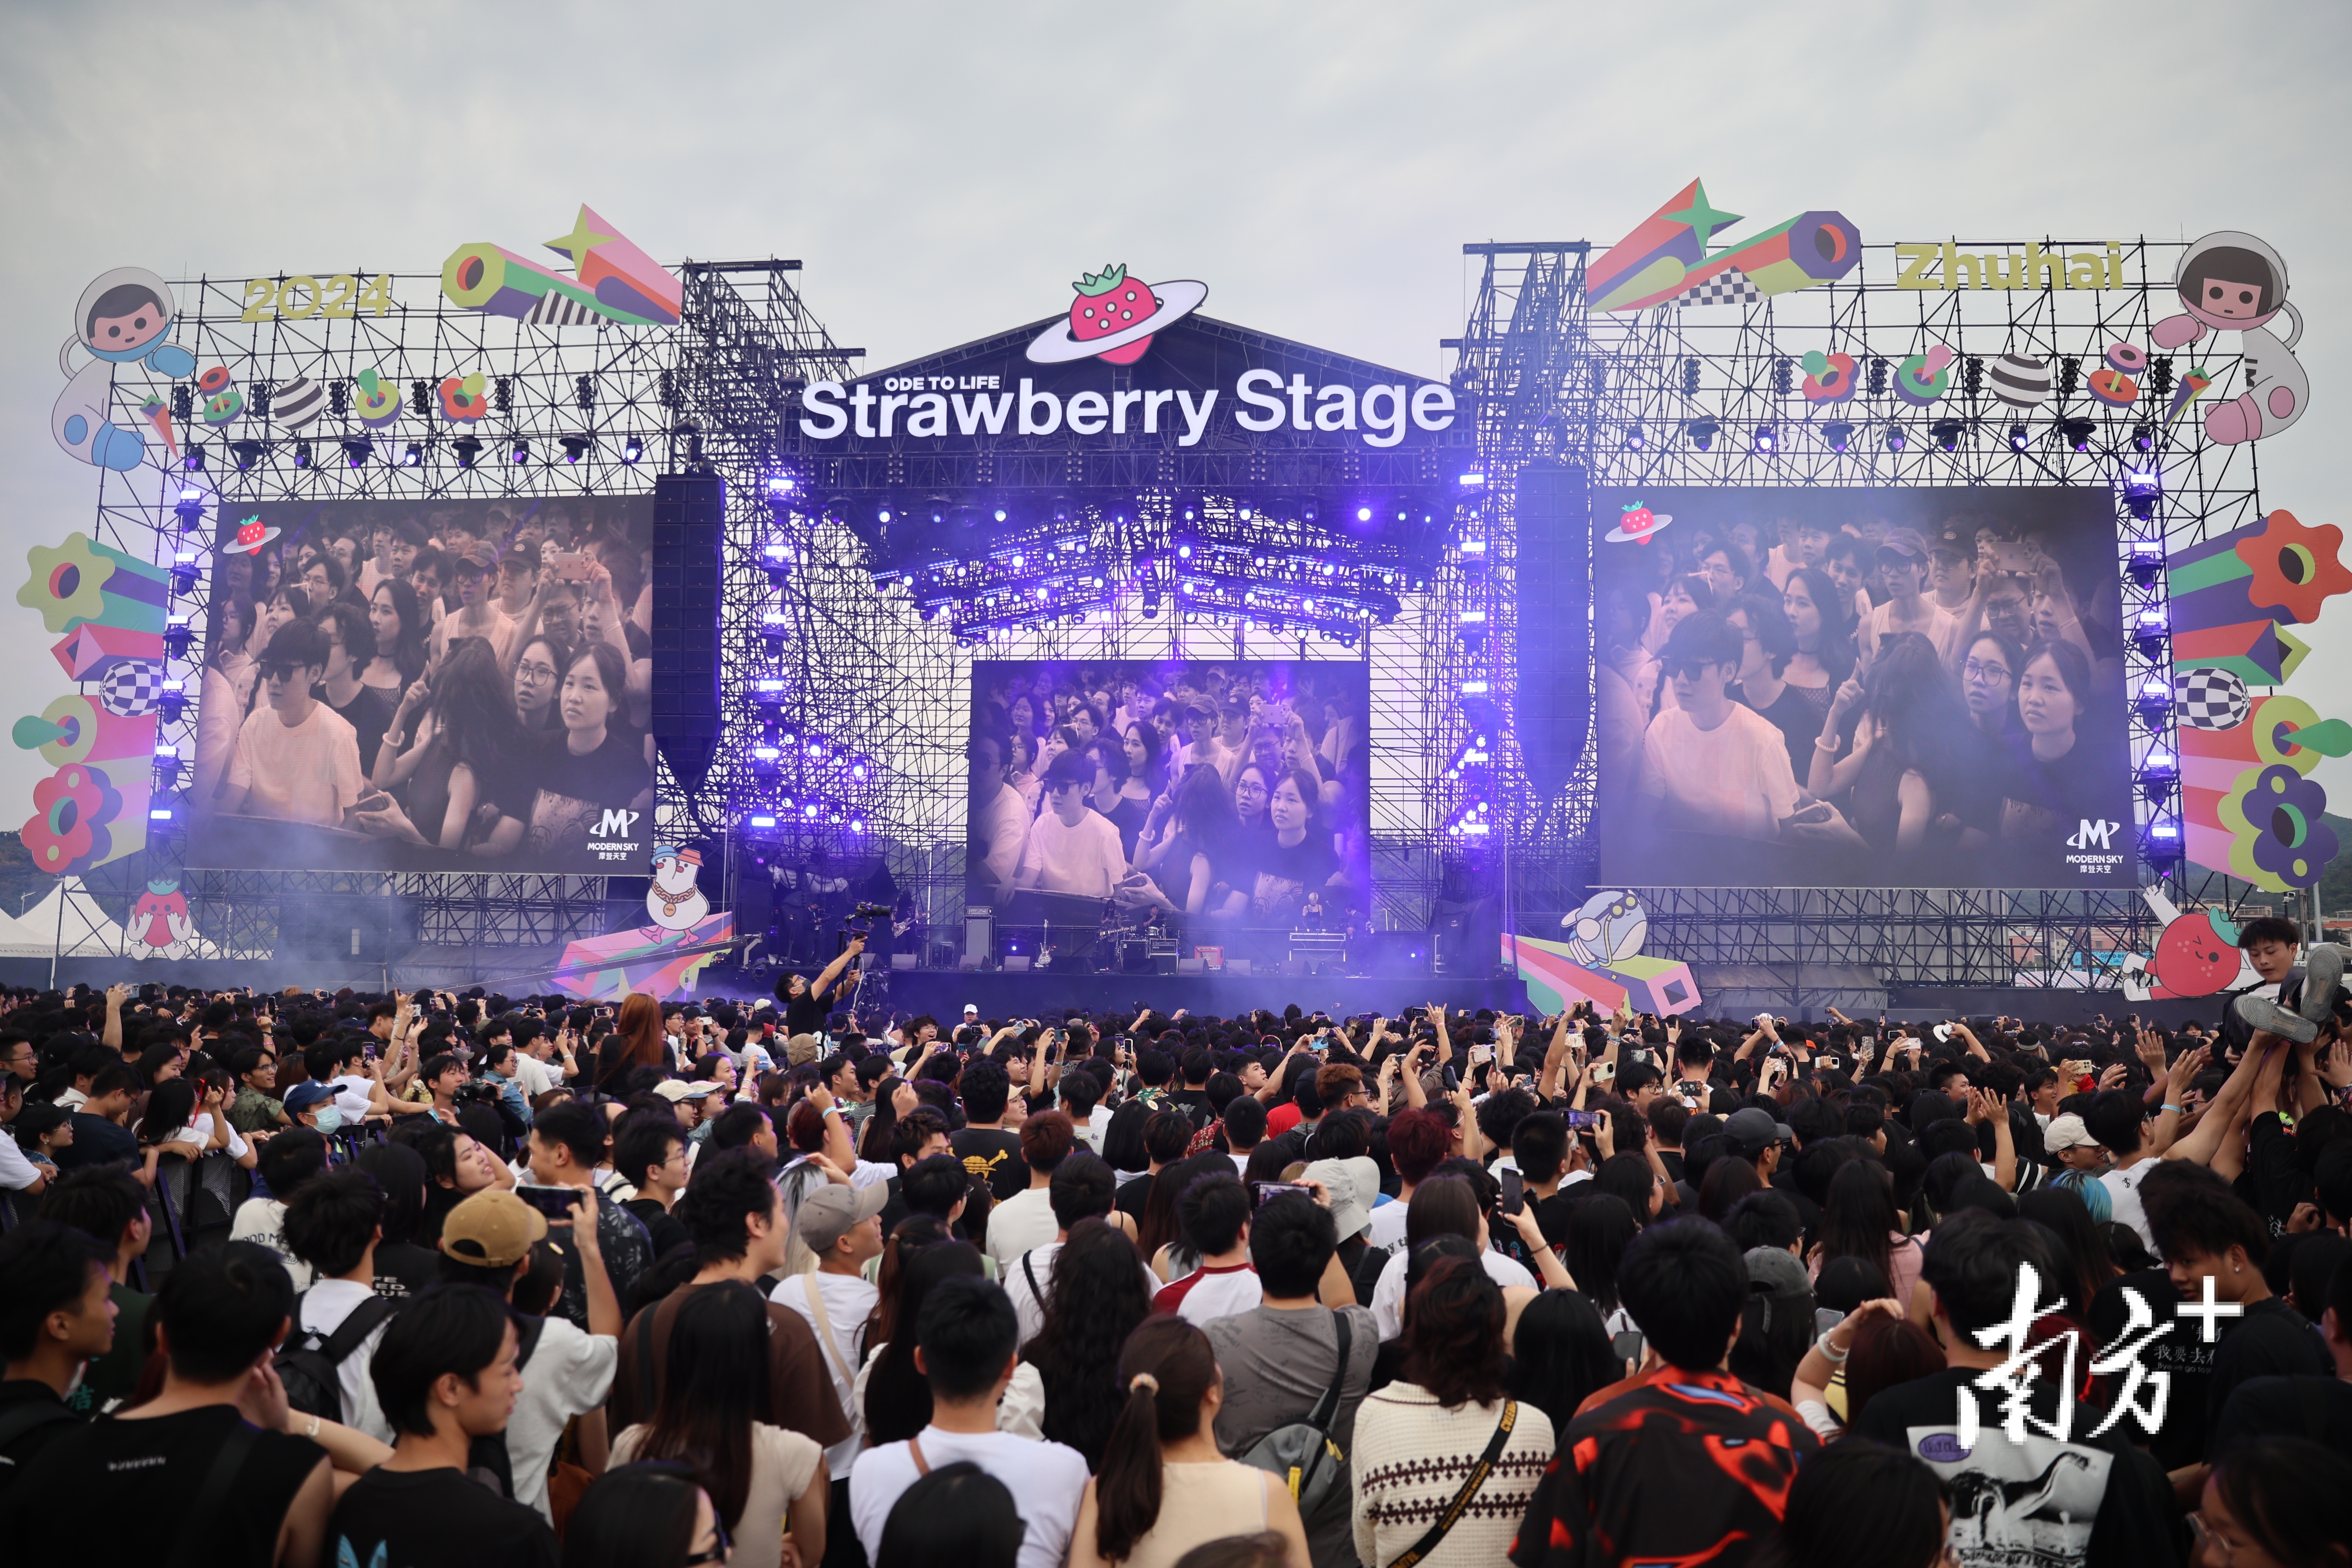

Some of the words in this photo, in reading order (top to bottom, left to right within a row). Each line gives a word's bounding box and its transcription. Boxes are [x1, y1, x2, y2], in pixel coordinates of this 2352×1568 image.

[1896, 241, 2123, 290] Zhuhai
[241, 274, 392, 323] 2024
[884, 377, 925, 391] ODE
[928, 376, 955, 390] TO
[960, 376, 1000, 389] LIFE
[800, 378, 1219, 446] Strawberry
[1235, 369, 1455, 447] Stage
[587, 842, 622, 851] MODERN
[623, 843, 639, 851] SKY
[598, 852, 627, 860] 摩登天空
[2066, 855, 2105, 863] MODERN
[2106, 855, 2123, 864] SKY
[2080, 865, 2112, 873] 摩登天空
